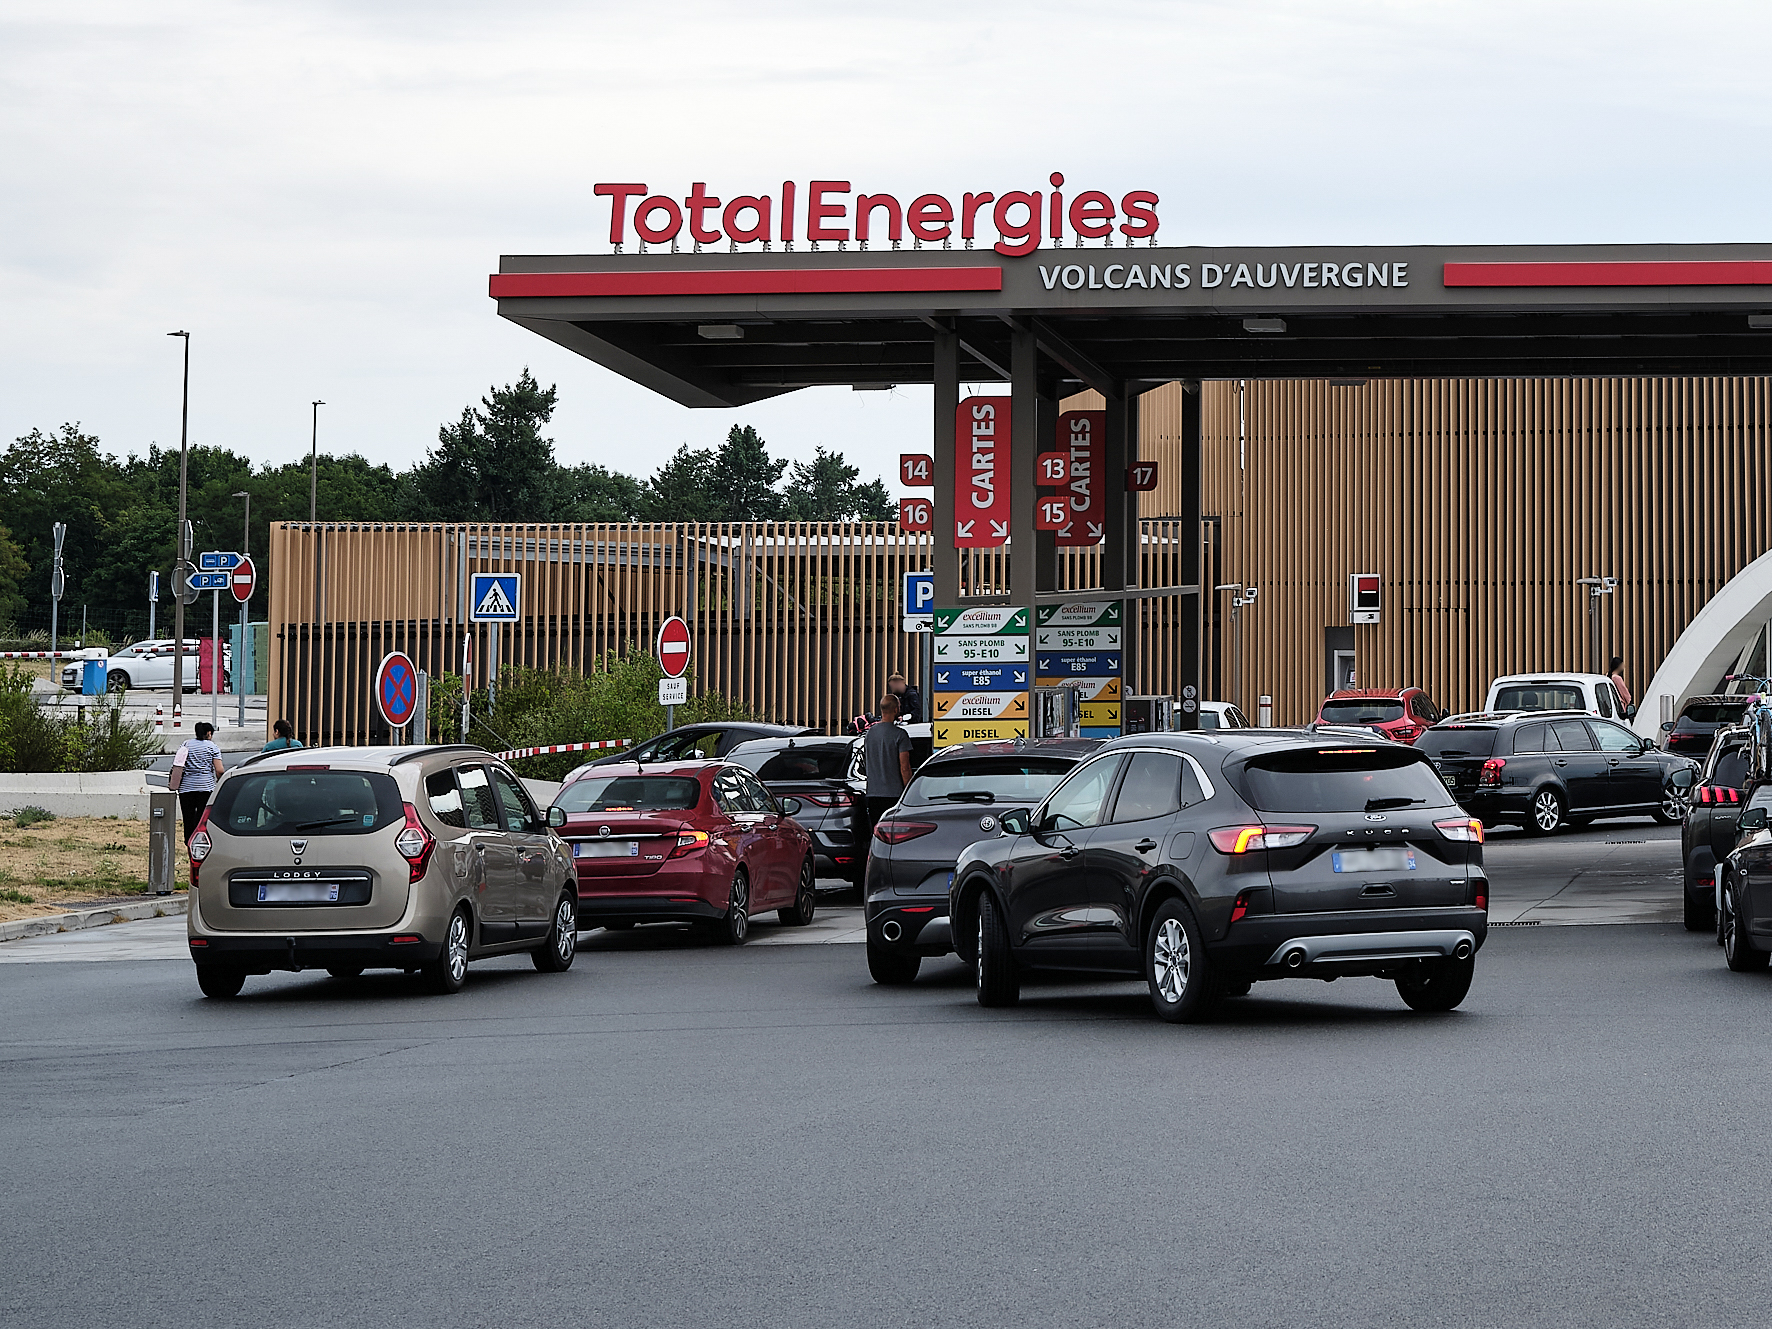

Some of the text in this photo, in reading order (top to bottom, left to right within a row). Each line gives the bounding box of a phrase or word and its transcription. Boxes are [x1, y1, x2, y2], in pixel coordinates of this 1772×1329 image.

[594, 171, 1160, 257] TotalEnergies
[1039, 262, 1410, 290] VOLCANS D'AUVERGNE
[971, 404, 995, 509] CARTES
[903, 459, 929, 480] 14
[1041, 458, 1065, 480] 13
[1070, 418, 1090, 512] CARTES
[1132, 467, 1153, 485] 17
[903, 504, 928, 524] 16
[1041, 503, 1065, 524] 15
[220, 557, 227, 565] P
[202, 577, 208, 585] P
[916, 581, 933, 608] P
[1062, 605, 1096, 613] excellium
[963, 612, 1001, 620] excellium
[1063, 639, 1094, 647] 95-E10
[964, 649, 999, 658] 95-E10
[1071, 663, 1086, 671] E85
[973, 676, 990, 685] E85
[667, 682, 680, 690] SAUF
[663, 692, 684, 700] SERVICE
[962, 696, 1000, 704] excellium
[963, 729, 999, 738] DIESEL
